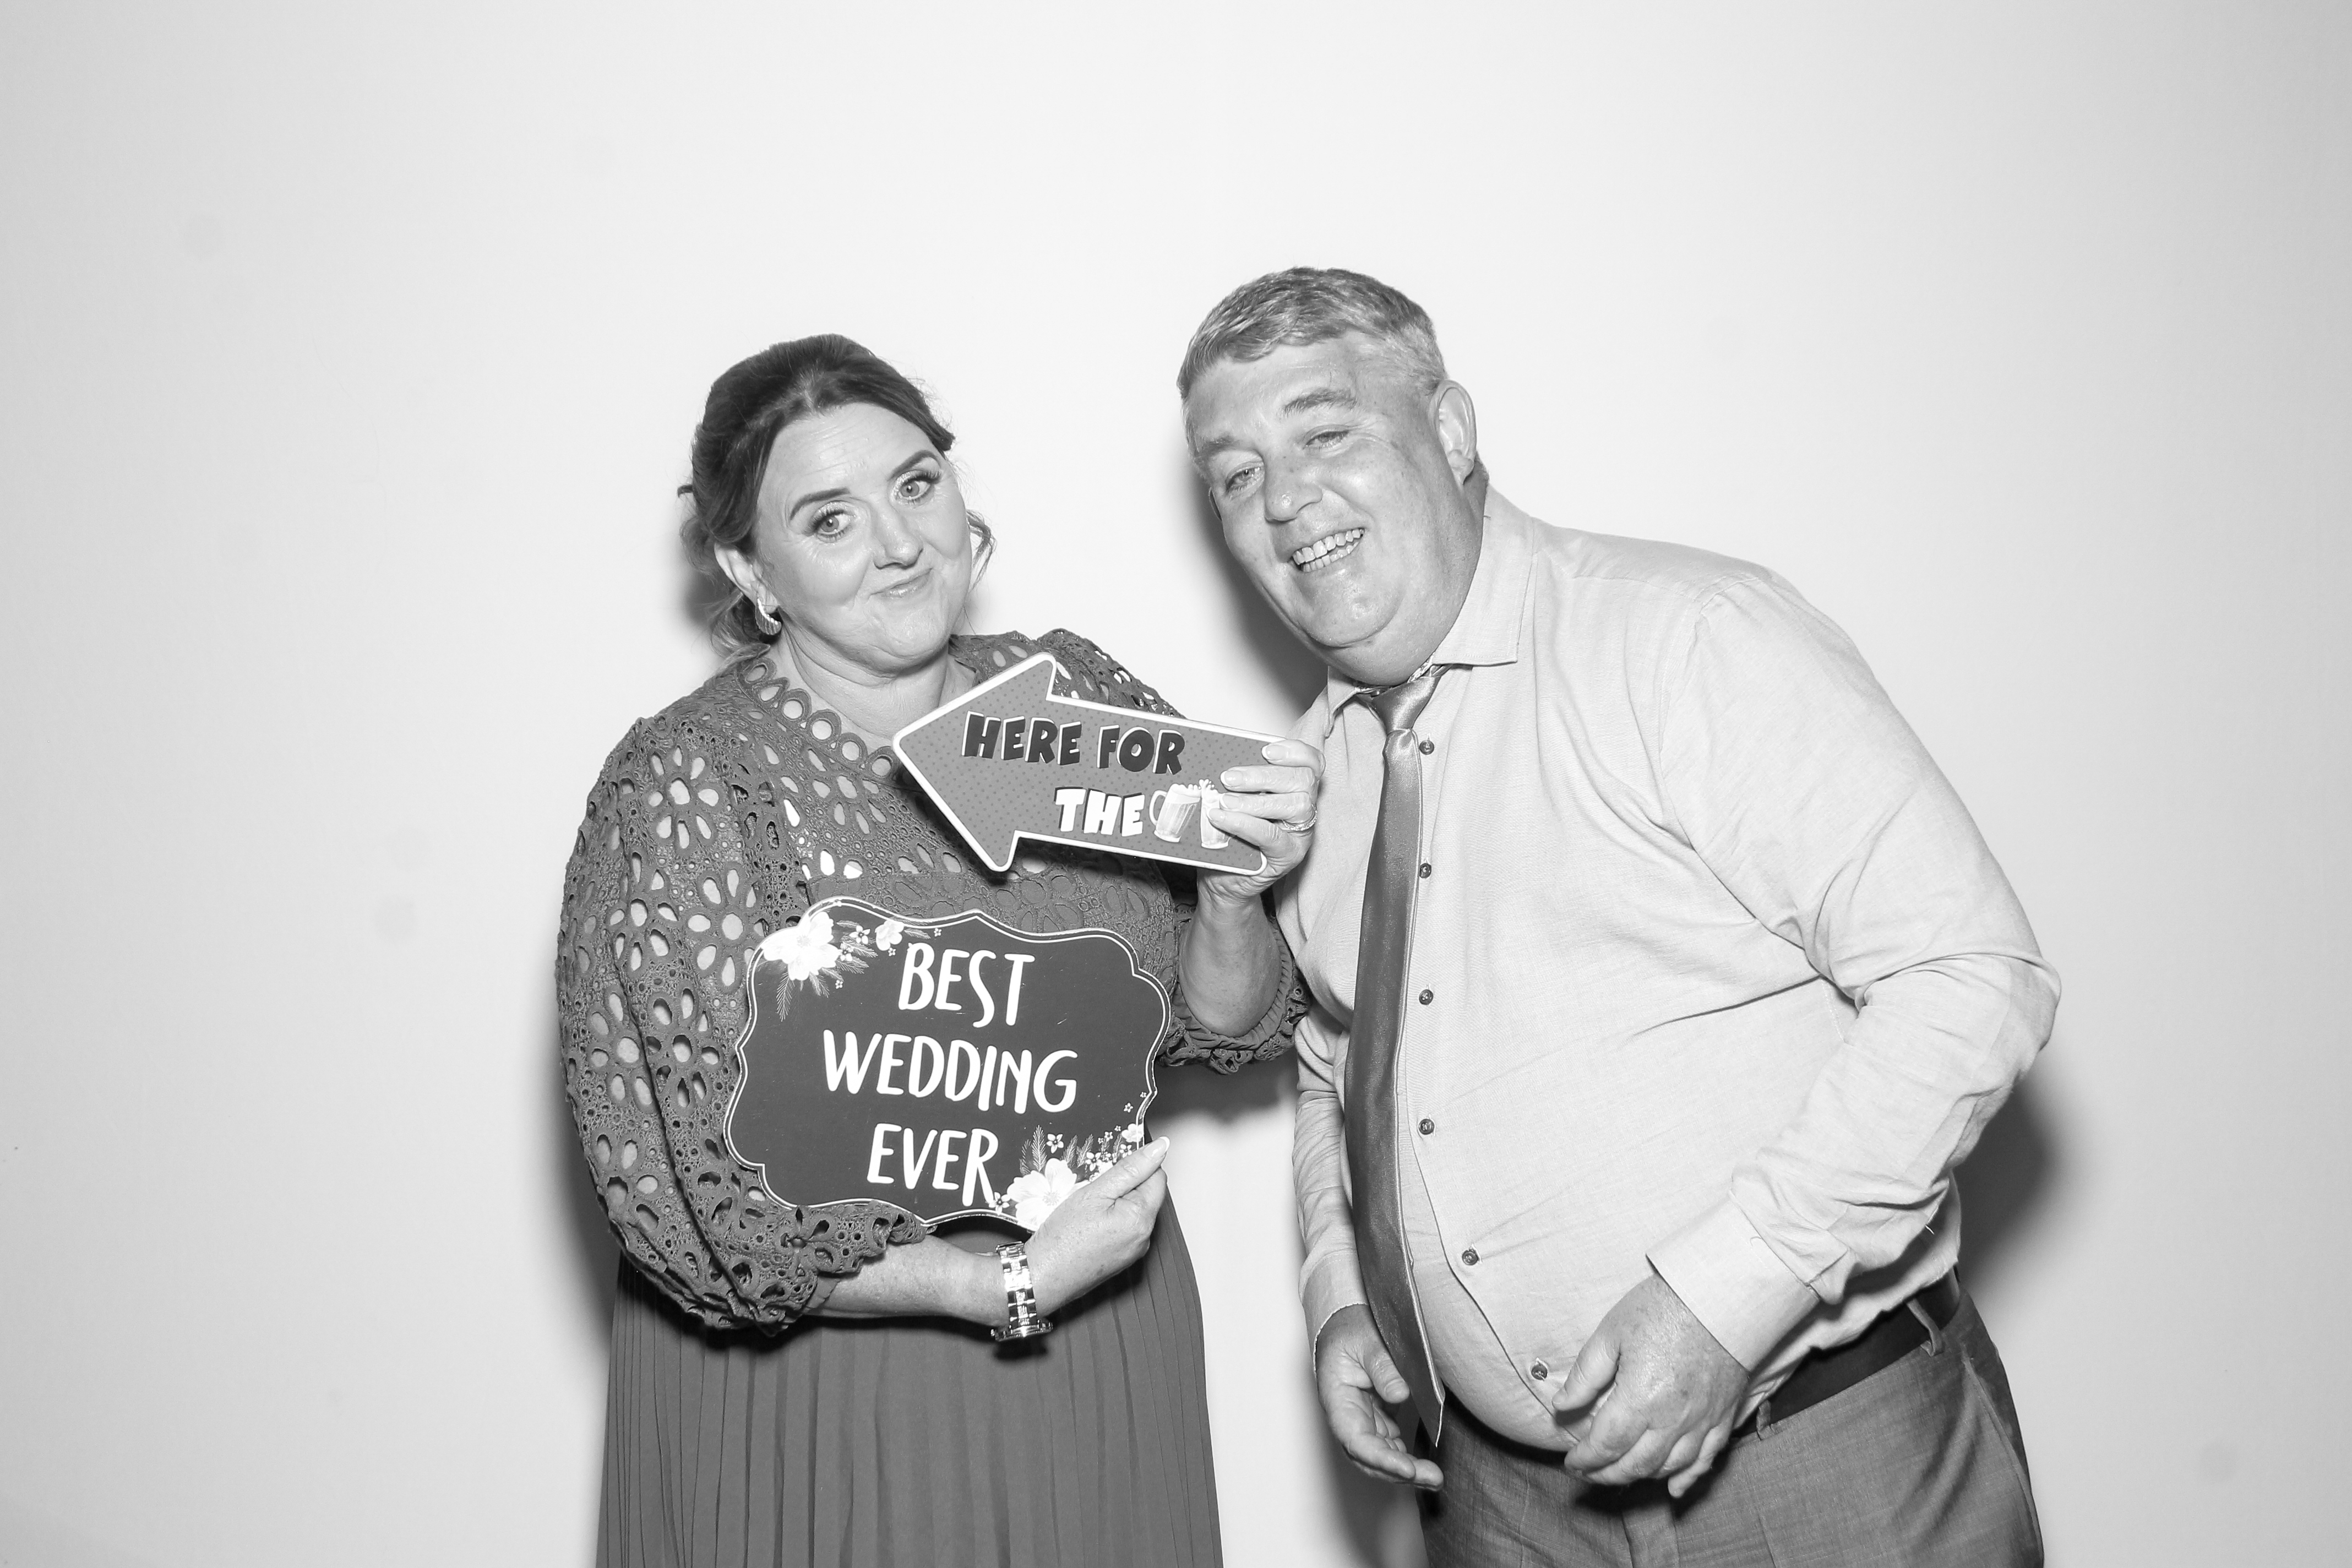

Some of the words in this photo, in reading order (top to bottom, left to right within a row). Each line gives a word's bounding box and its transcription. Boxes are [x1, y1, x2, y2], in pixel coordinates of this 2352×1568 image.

[961, 710, 1082, 766] HERE
[1097, 725, 1186, 776] FOR
[1054, 786, 1145, 837] THE
[898, 942, 1035, 1028] BEST
[823, 1028, 1078, 1114] WEDDING
[867, 1123, 999, 1207] EVER
